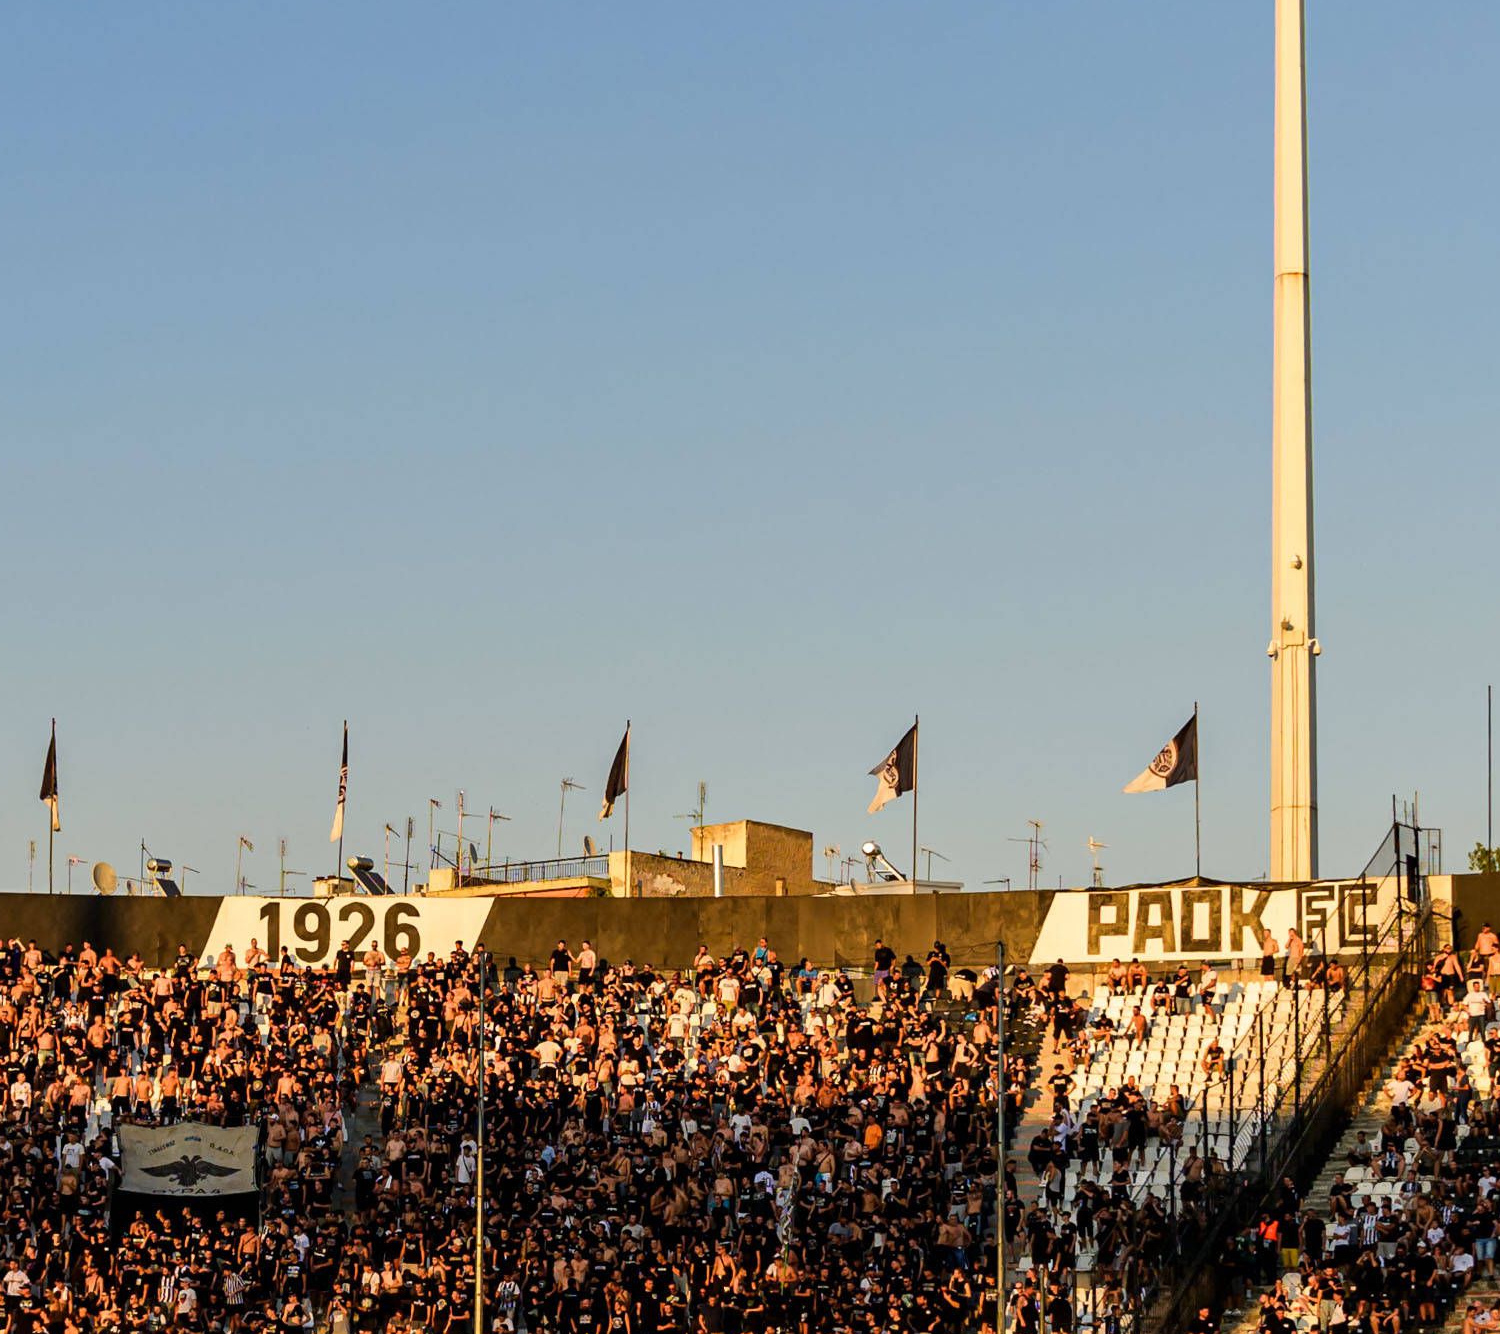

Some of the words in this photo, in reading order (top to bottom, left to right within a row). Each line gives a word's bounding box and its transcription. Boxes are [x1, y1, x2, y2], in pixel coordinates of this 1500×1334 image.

[259, 900, 422, 963] 1926
[1087, 884, 1272, 955] PAOK
[1297, 881, 1379, 949] FC
